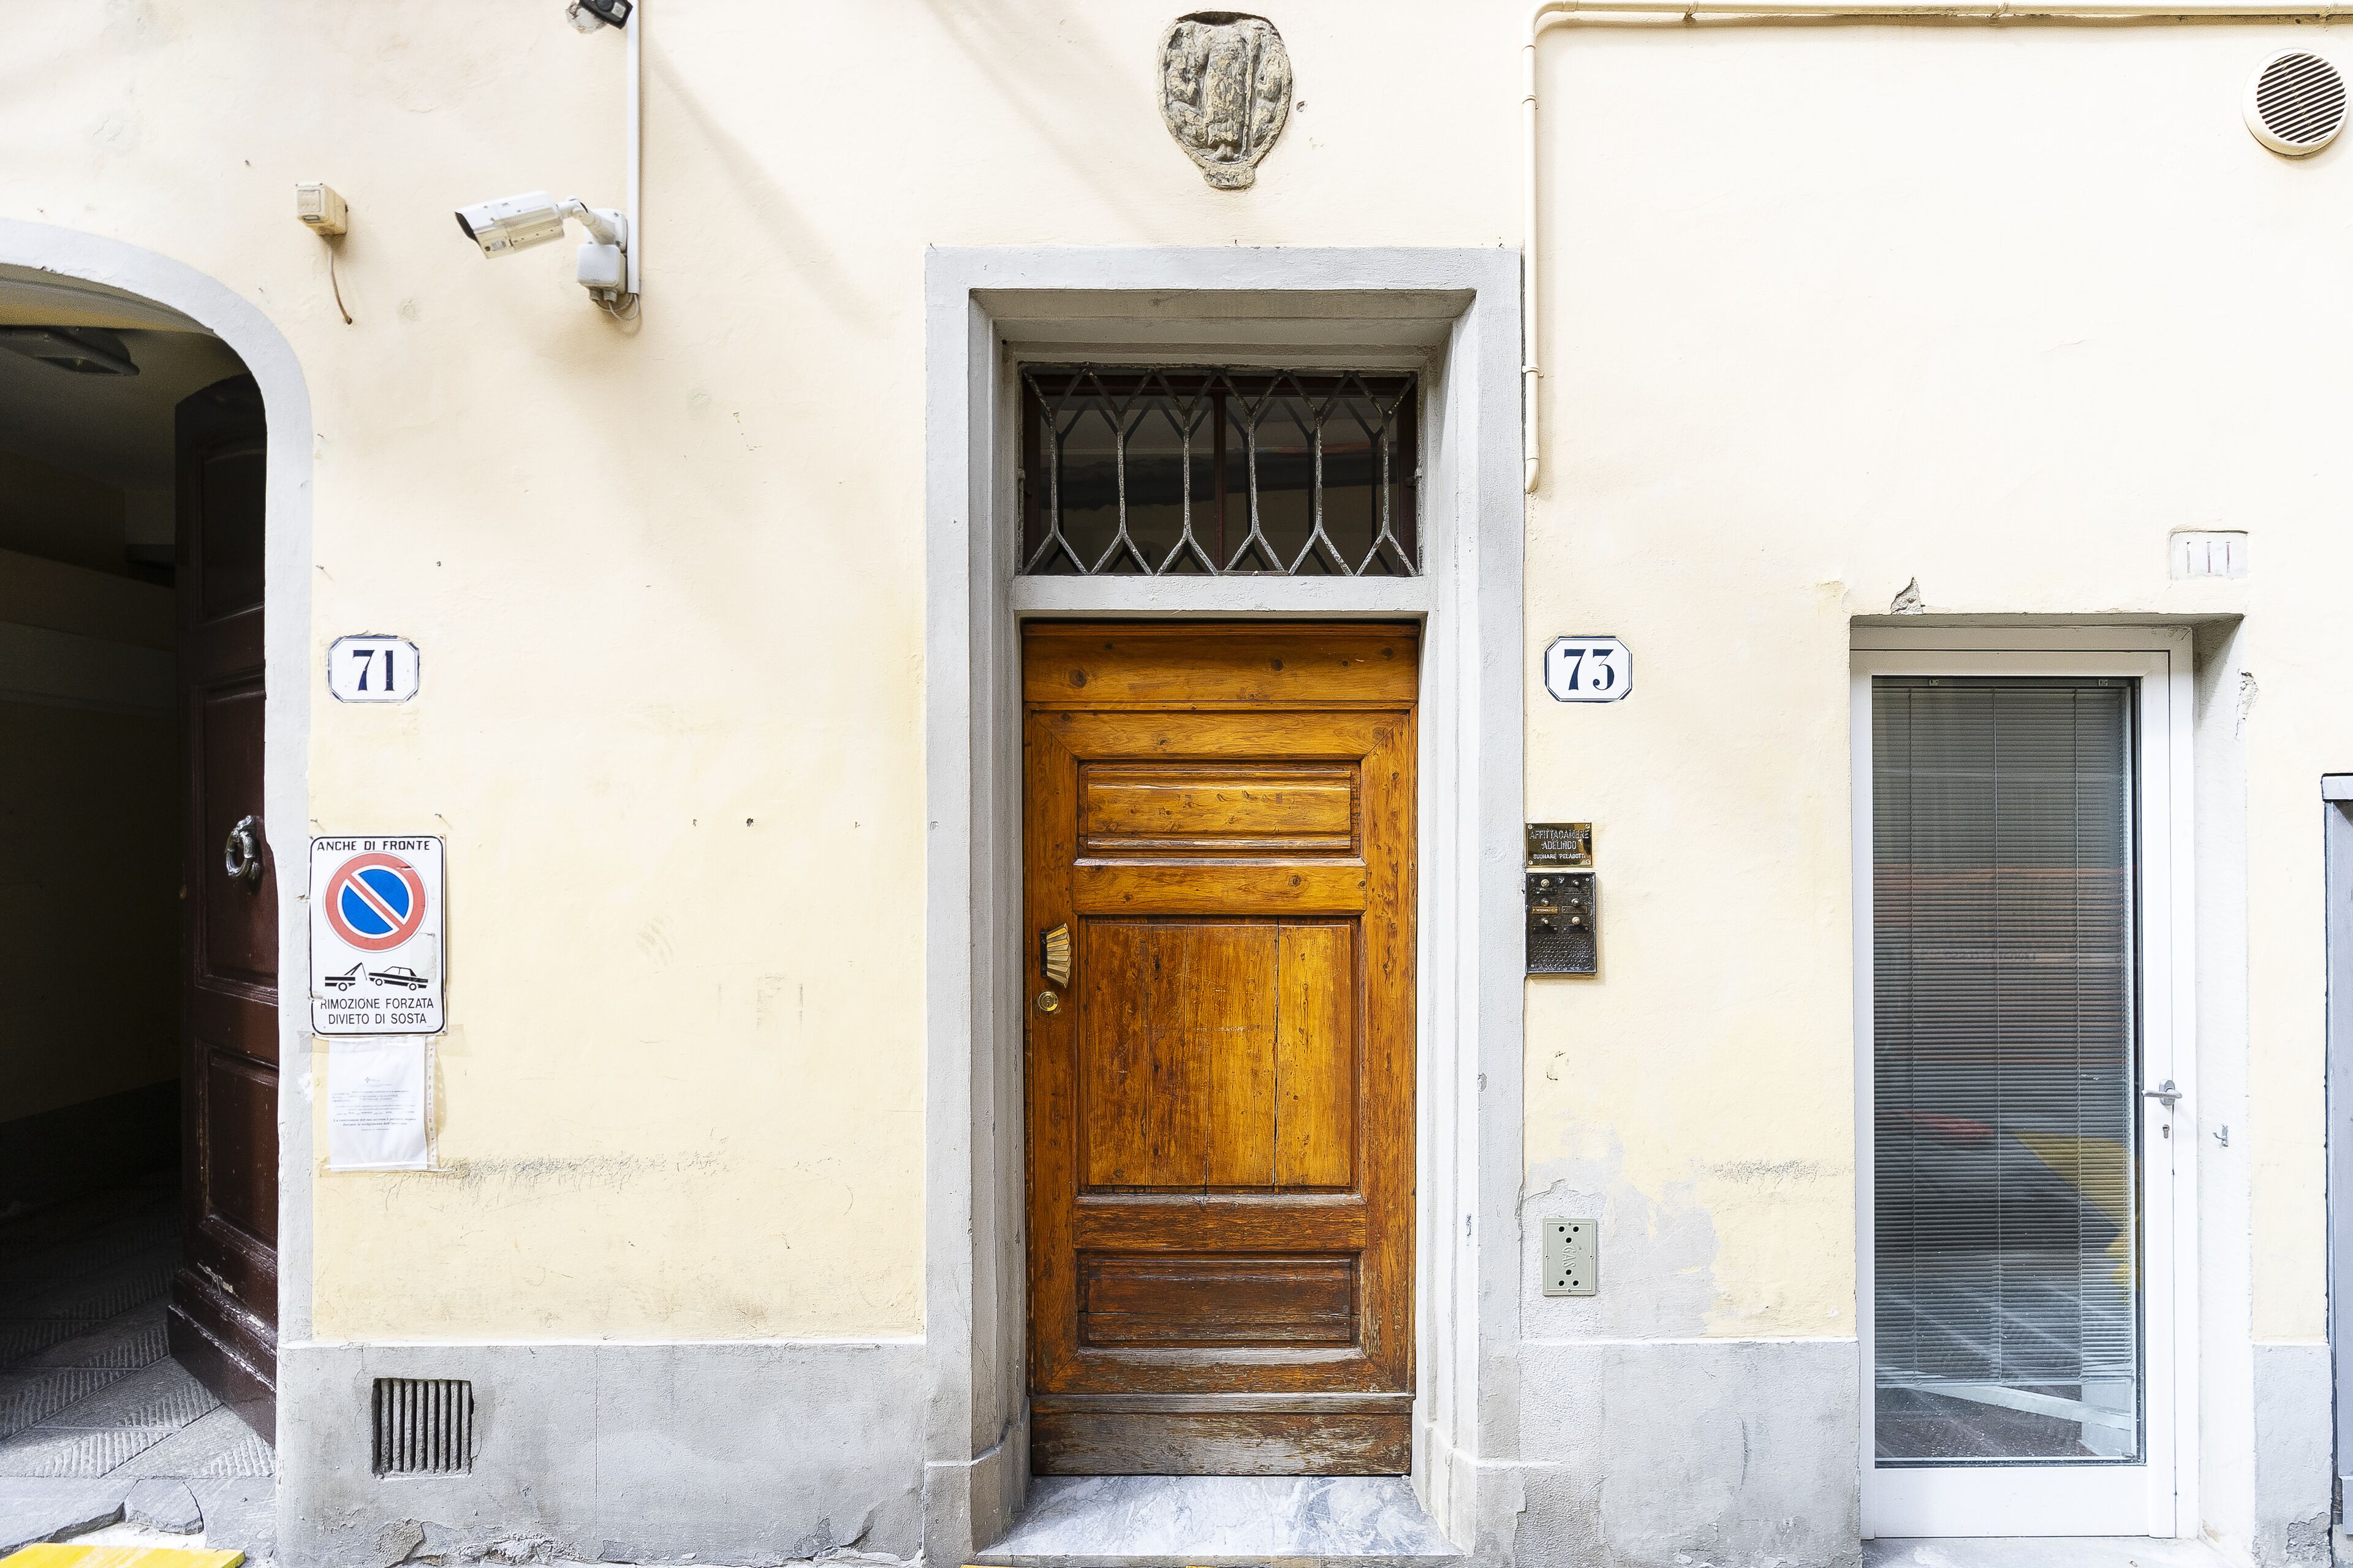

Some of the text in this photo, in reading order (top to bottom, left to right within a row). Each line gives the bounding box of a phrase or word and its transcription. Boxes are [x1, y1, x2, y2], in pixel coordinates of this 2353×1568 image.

[352, 650, 395, 692] 71
[1564, 649, 1615, 691] 73
[1529, 830, 1590, 839] AFFITTACAMERE
[317, 840, 431, 851] ANCHE DI FRONTE
[1541, 841, 1577, 850] ADELINDO
[320, 998, 434, 1009] RIMOZIONE FORZATA
[328, 1013, 427, 1025] DIVIETO DI SOSTA
[1561, 1246, 1577, 1268] GAS
